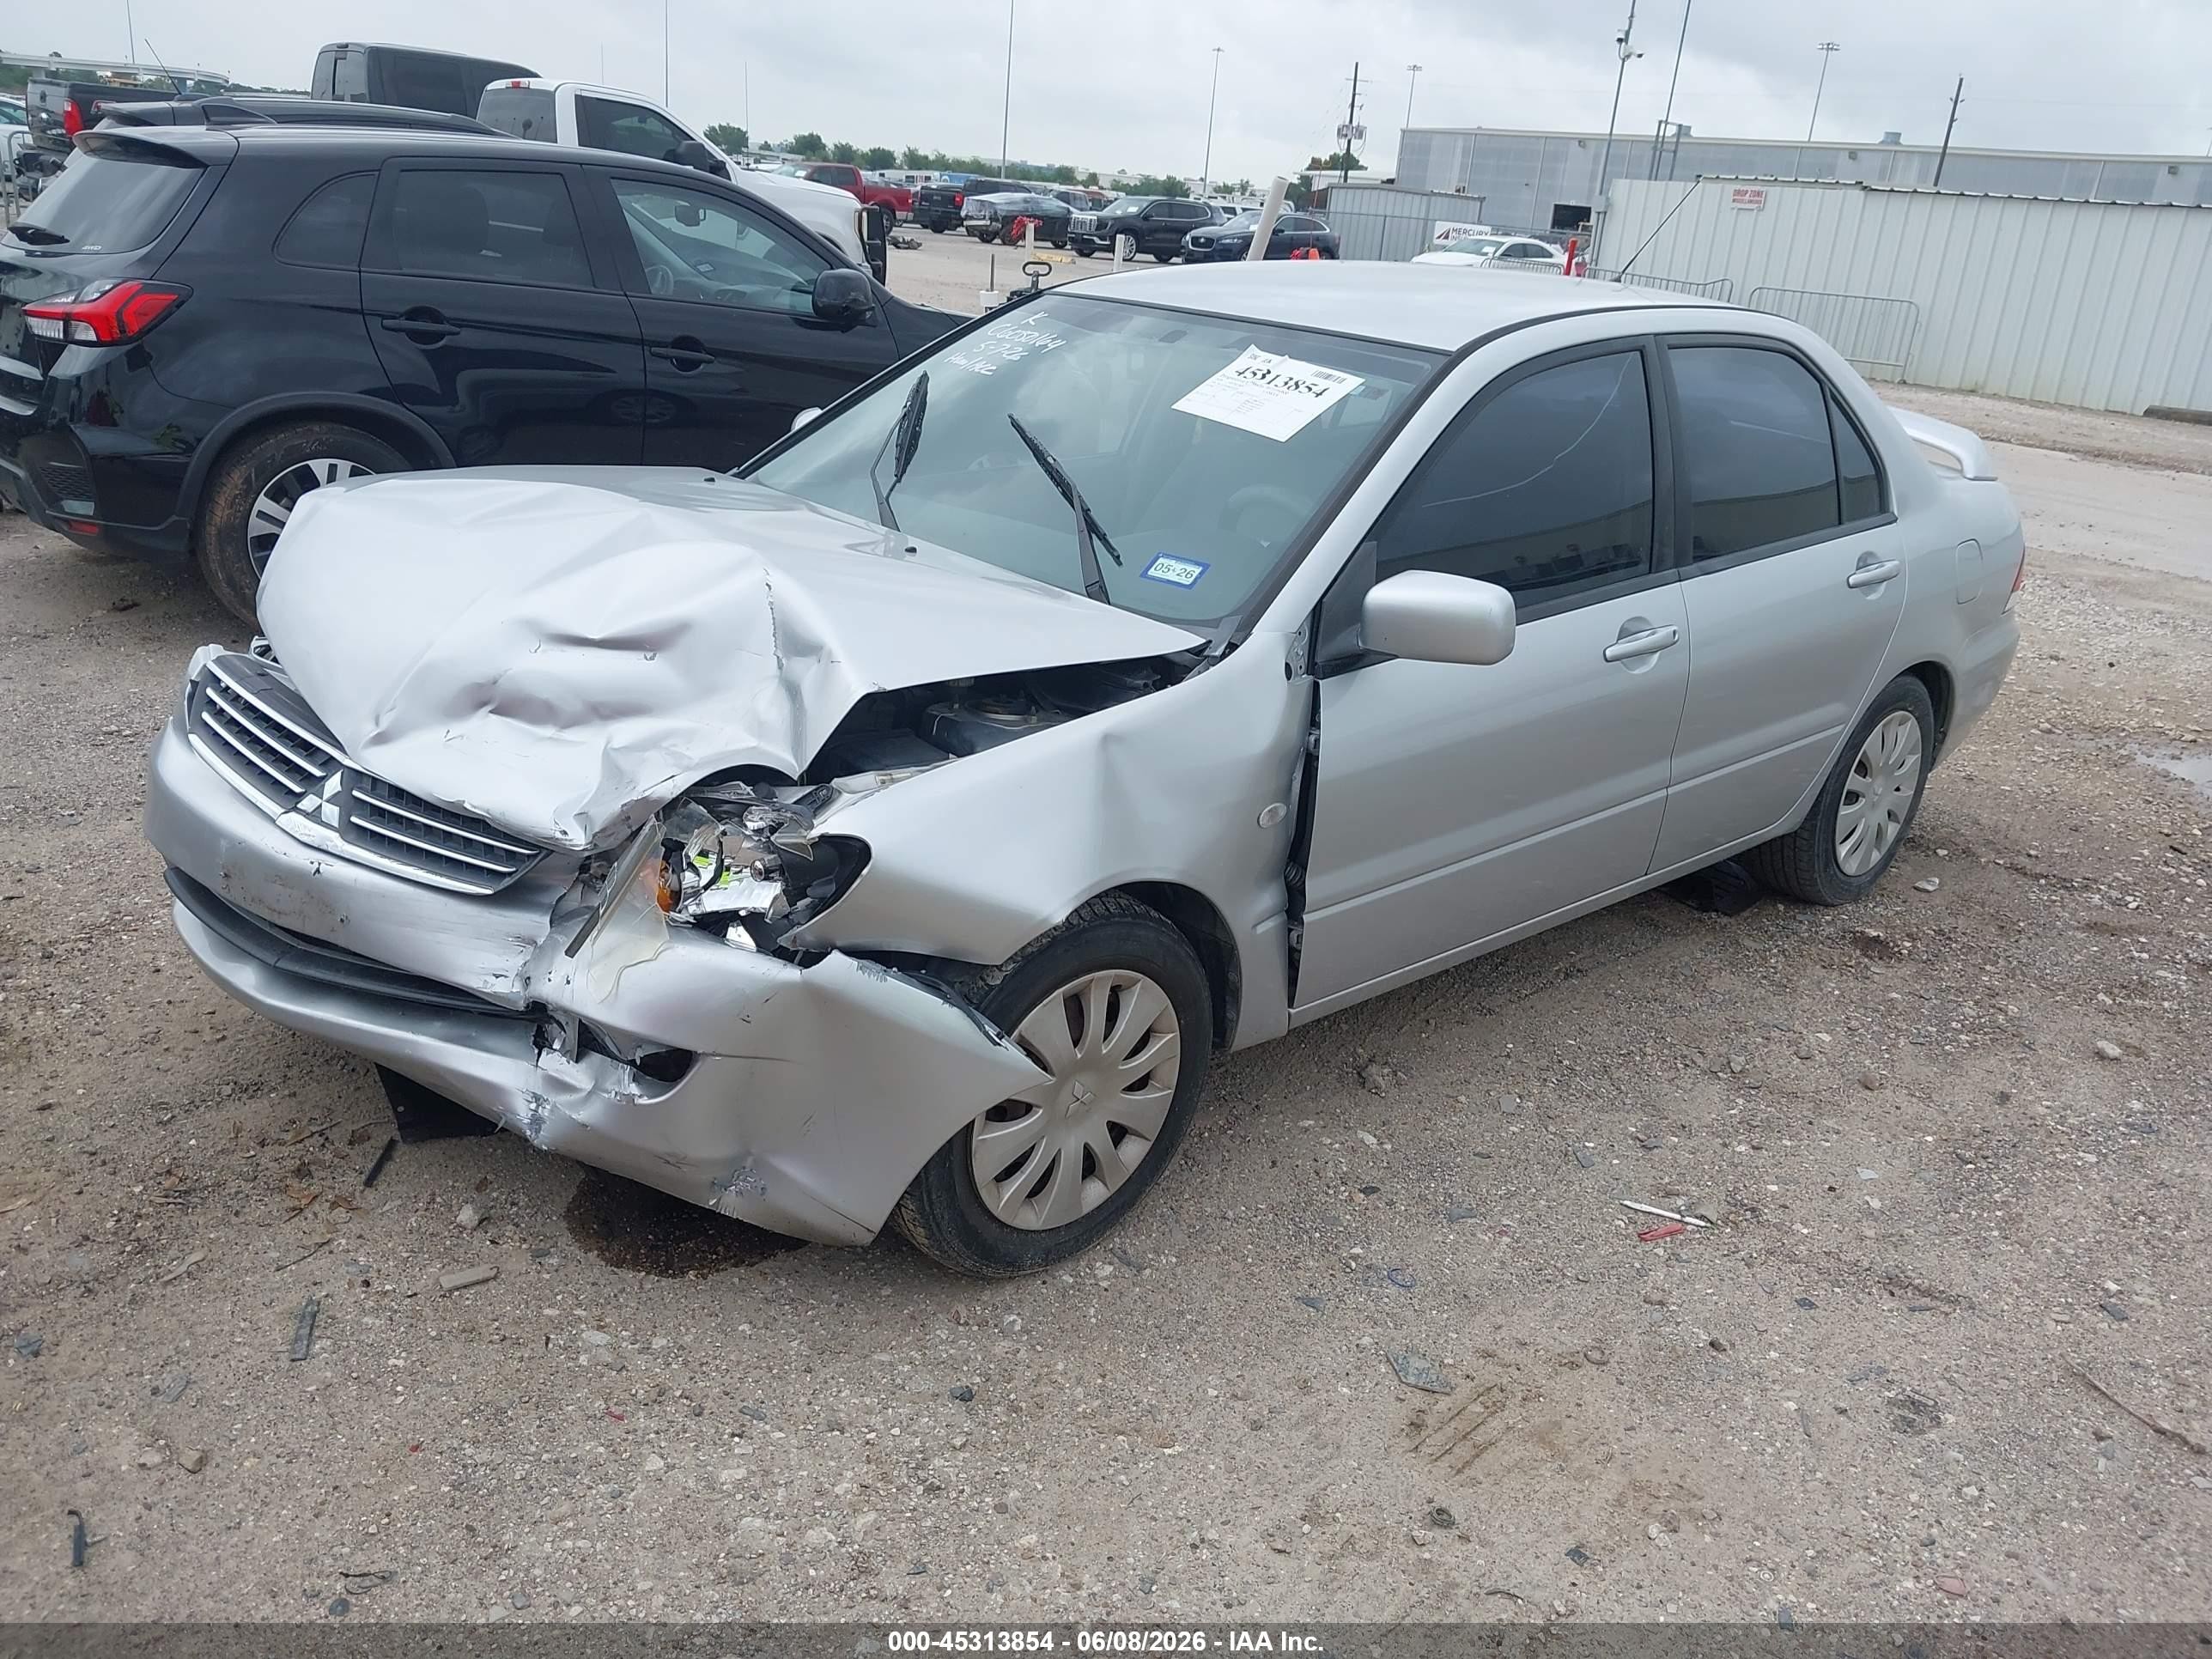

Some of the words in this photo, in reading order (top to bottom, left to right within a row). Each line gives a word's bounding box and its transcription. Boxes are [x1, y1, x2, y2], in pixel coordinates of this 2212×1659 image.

[1235, 366, 1330, 398] 45313854
[1153, 562, 1174, 574] 05
[1176, 567, 1196, 579] 26
